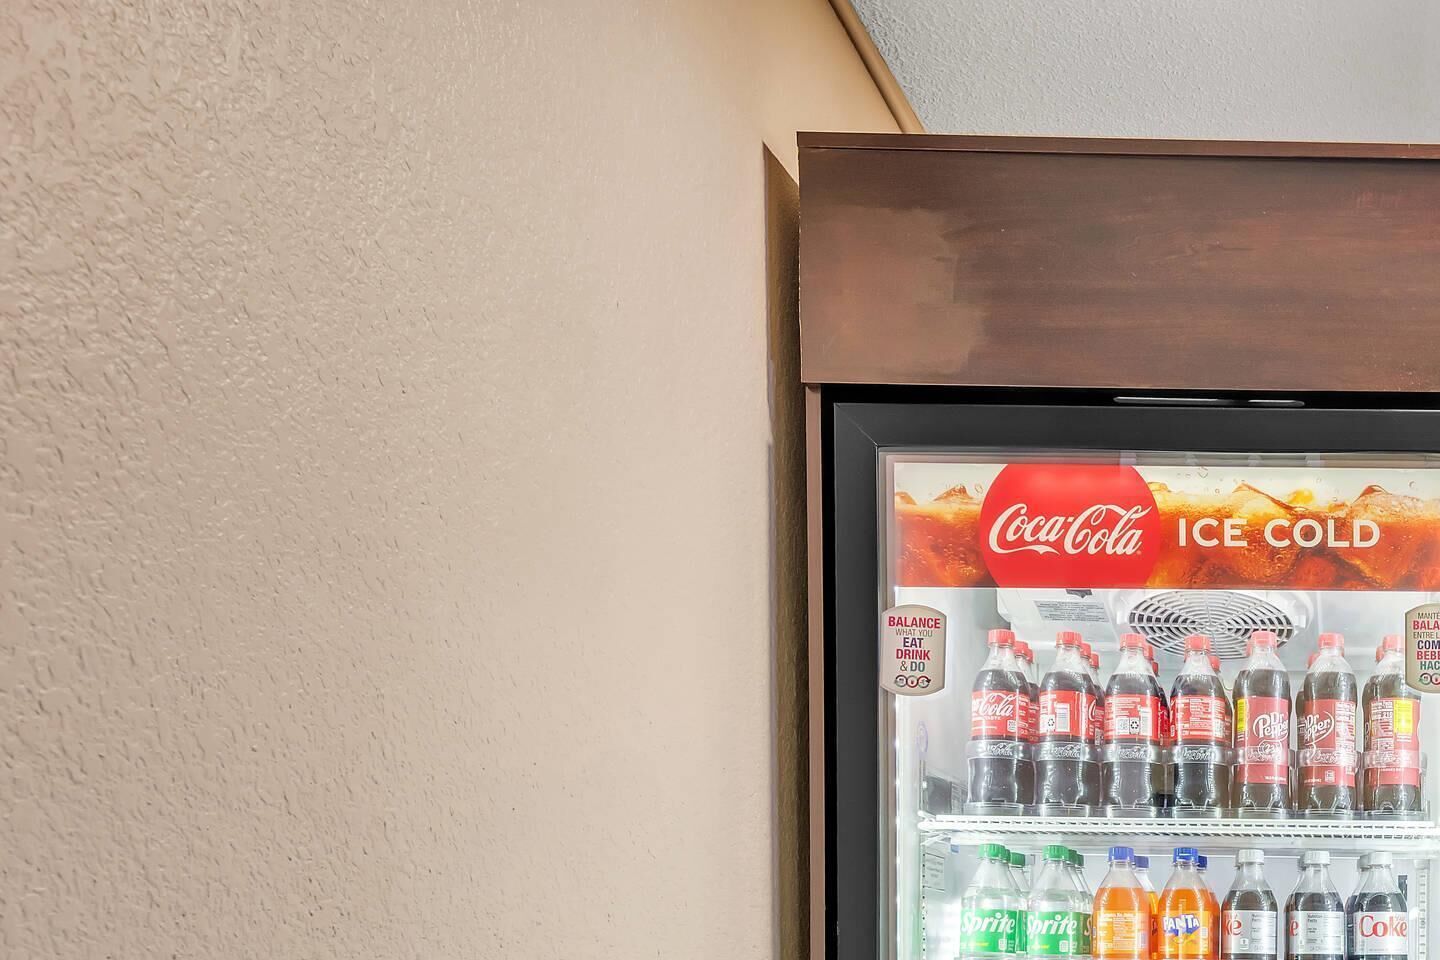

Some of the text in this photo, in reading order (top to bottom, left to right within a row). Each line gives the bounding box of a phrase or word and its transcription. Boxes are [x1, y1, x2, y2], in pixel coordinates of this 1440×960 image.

[988, 503, 1152, 556] Coca-Cola
[1178, 518, 1380, 548] ICE COLD
[888, 616, 941, 629] BALANCE
[895, 628, 933, 637] WHAT YOU
[1413, 631, 1436, 639] ENTRE
[896, 649, 931, 661] DRINK
[899, 660, 926, 673] & DO
[1271, 711, 1284, 724] Dr
[1306, 713, 1319, 726] Dr
[962, 912, 1016, 936] Sprite
[1027, 914, 1077, 936] Sprite
[1163, 914, 1200, 932] FANTA
[1359, 915, 1407, 938] Coke
